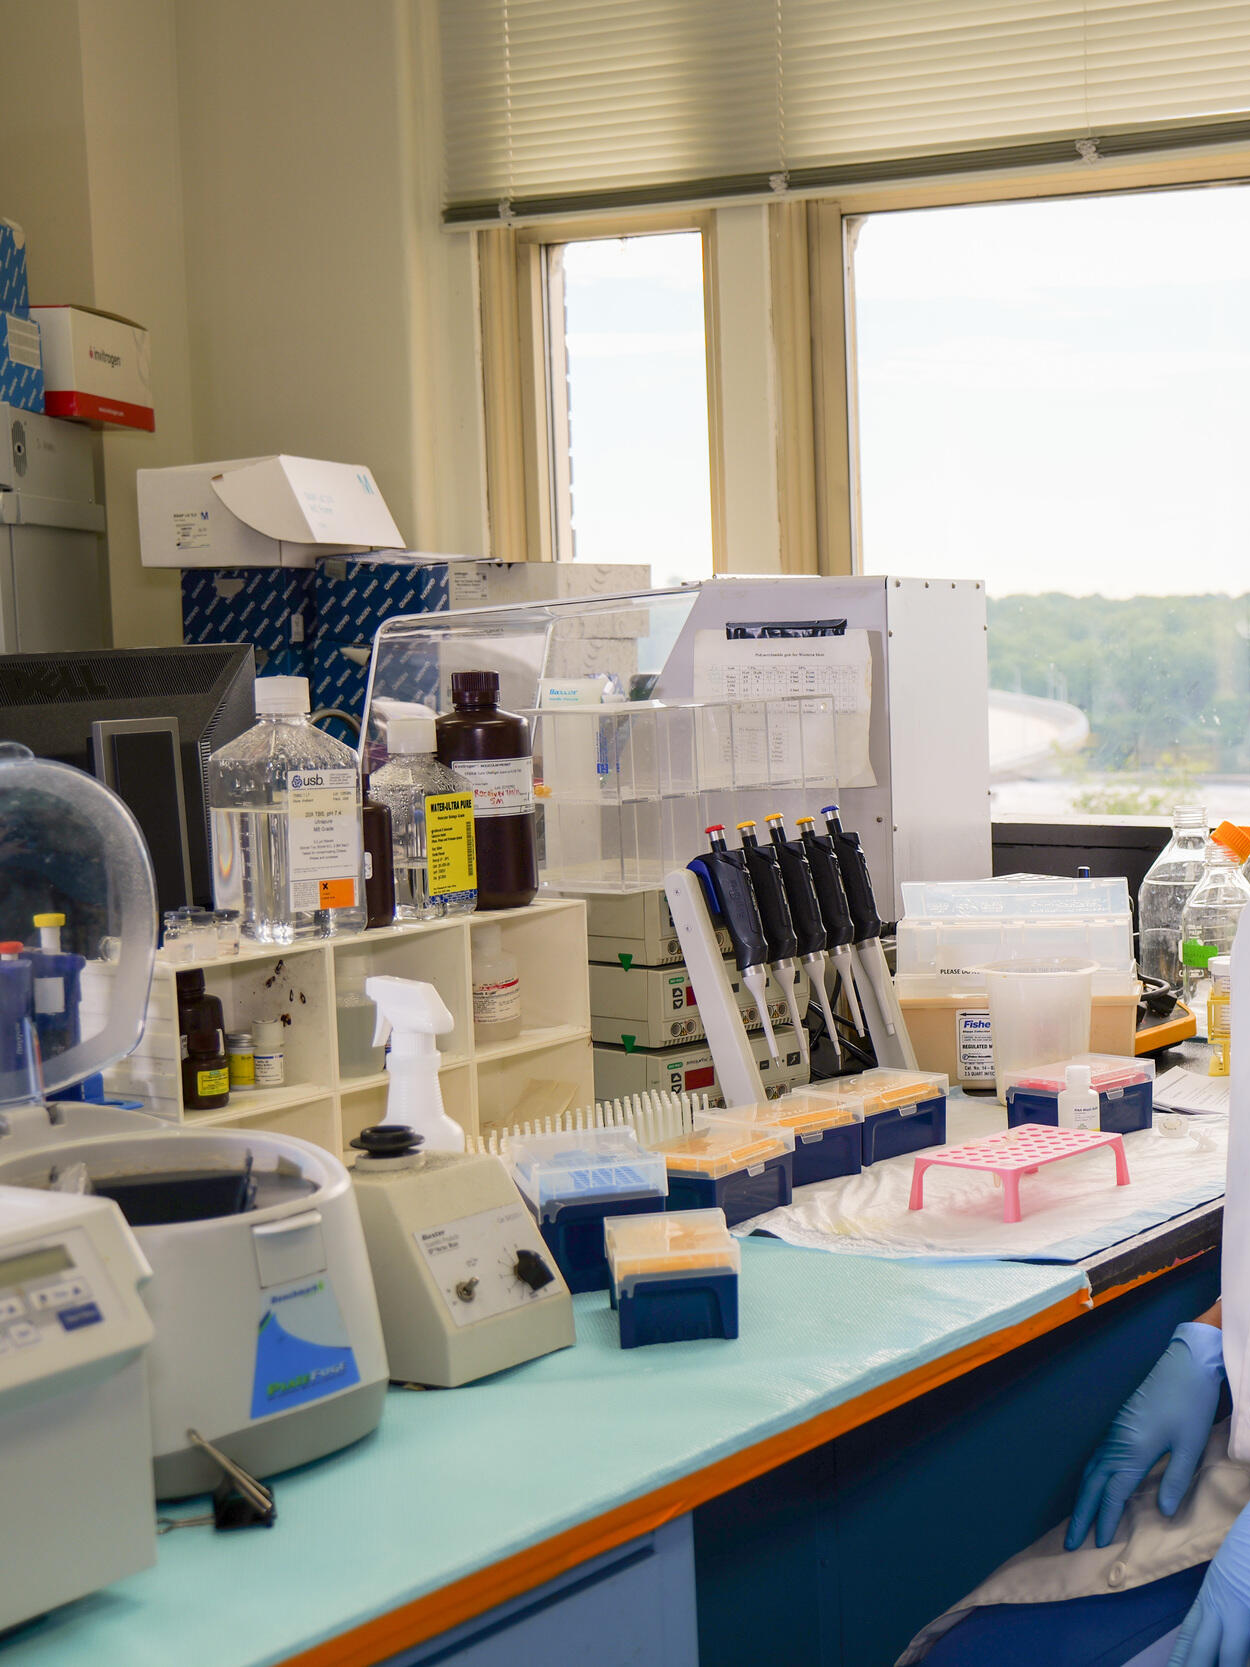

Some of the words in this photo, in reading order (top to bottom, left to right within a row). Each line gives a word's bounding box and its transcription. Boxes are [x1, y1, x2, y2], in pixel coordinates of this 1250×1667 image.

[303, 774, 324, 787] usb
[430, 800, 460, 812] WATER-ULTRA
[460, 799, 472, 809] PURE
[963, 1020, 992, 1029] Fishe
